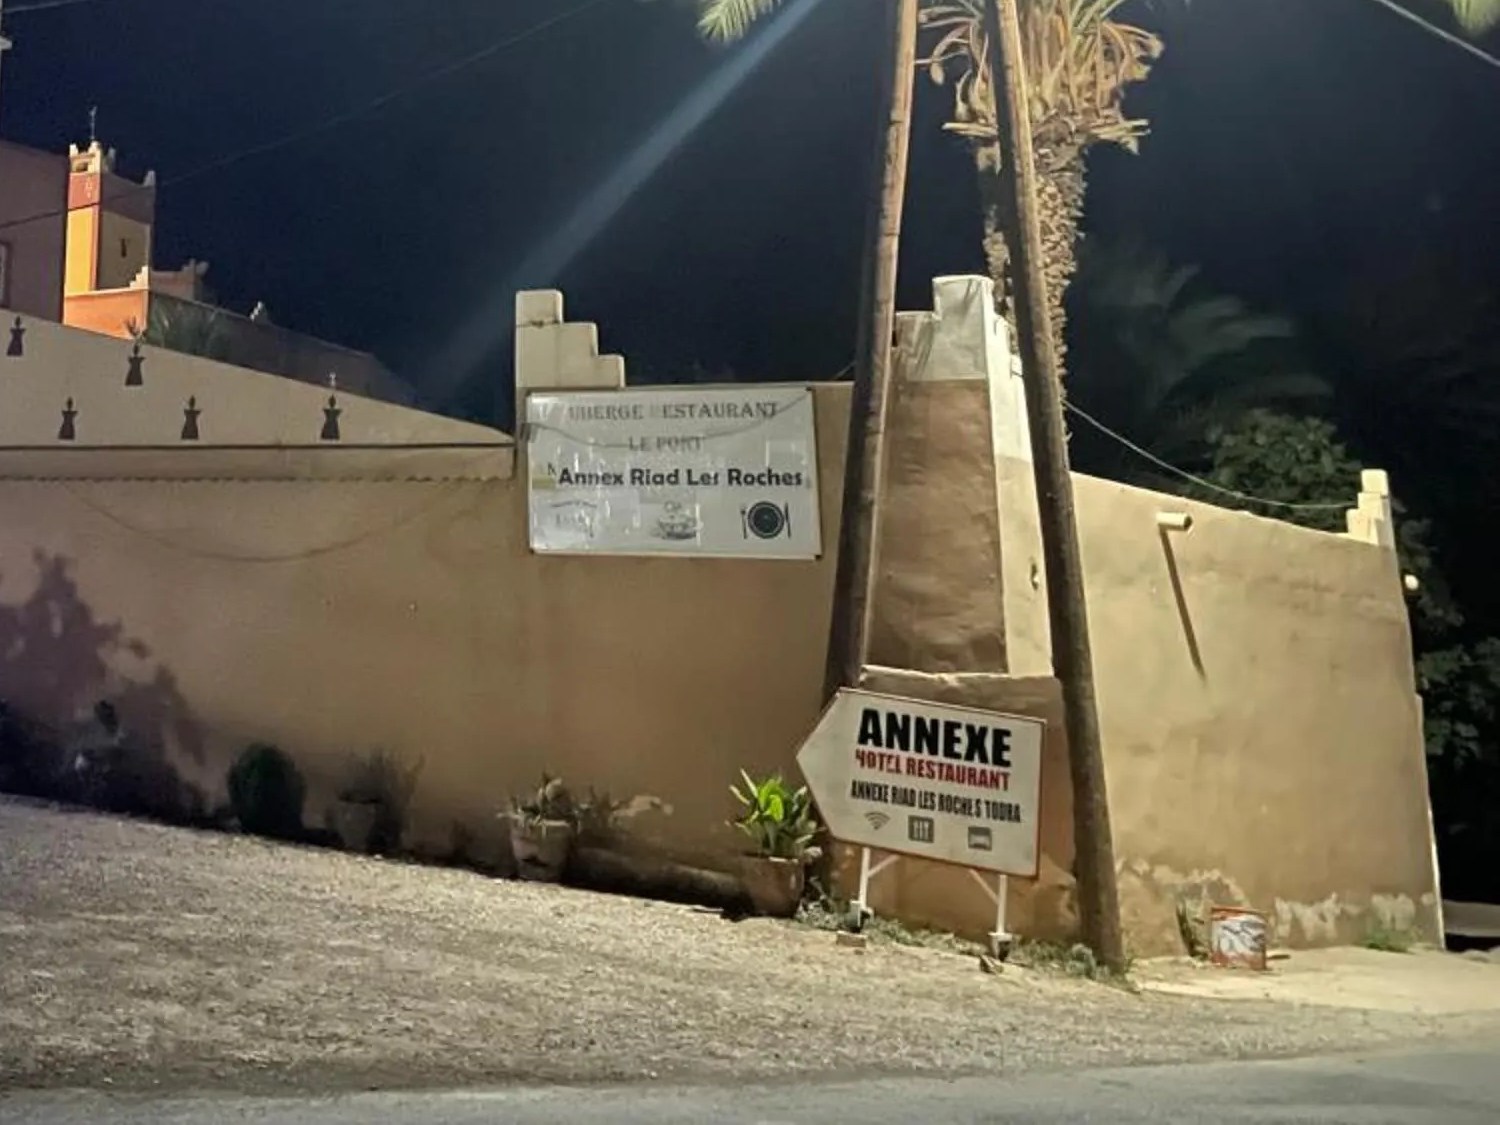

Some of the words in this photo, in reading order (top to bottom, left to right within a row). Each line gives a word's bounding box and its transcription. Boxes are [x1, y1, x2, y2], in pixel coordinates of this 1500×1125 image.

[559, 467, 623, 485] Annex
[630, 468, 679, 485] Riad
[727, 466, 802, 486] Roches
[857, 708, 1011, 767] ANNEXE
[906, 757, 1011, 791] RESTAURANT
[851, 779, 888, 803] ANNEXE
[918, 790, 936, 811] LES
